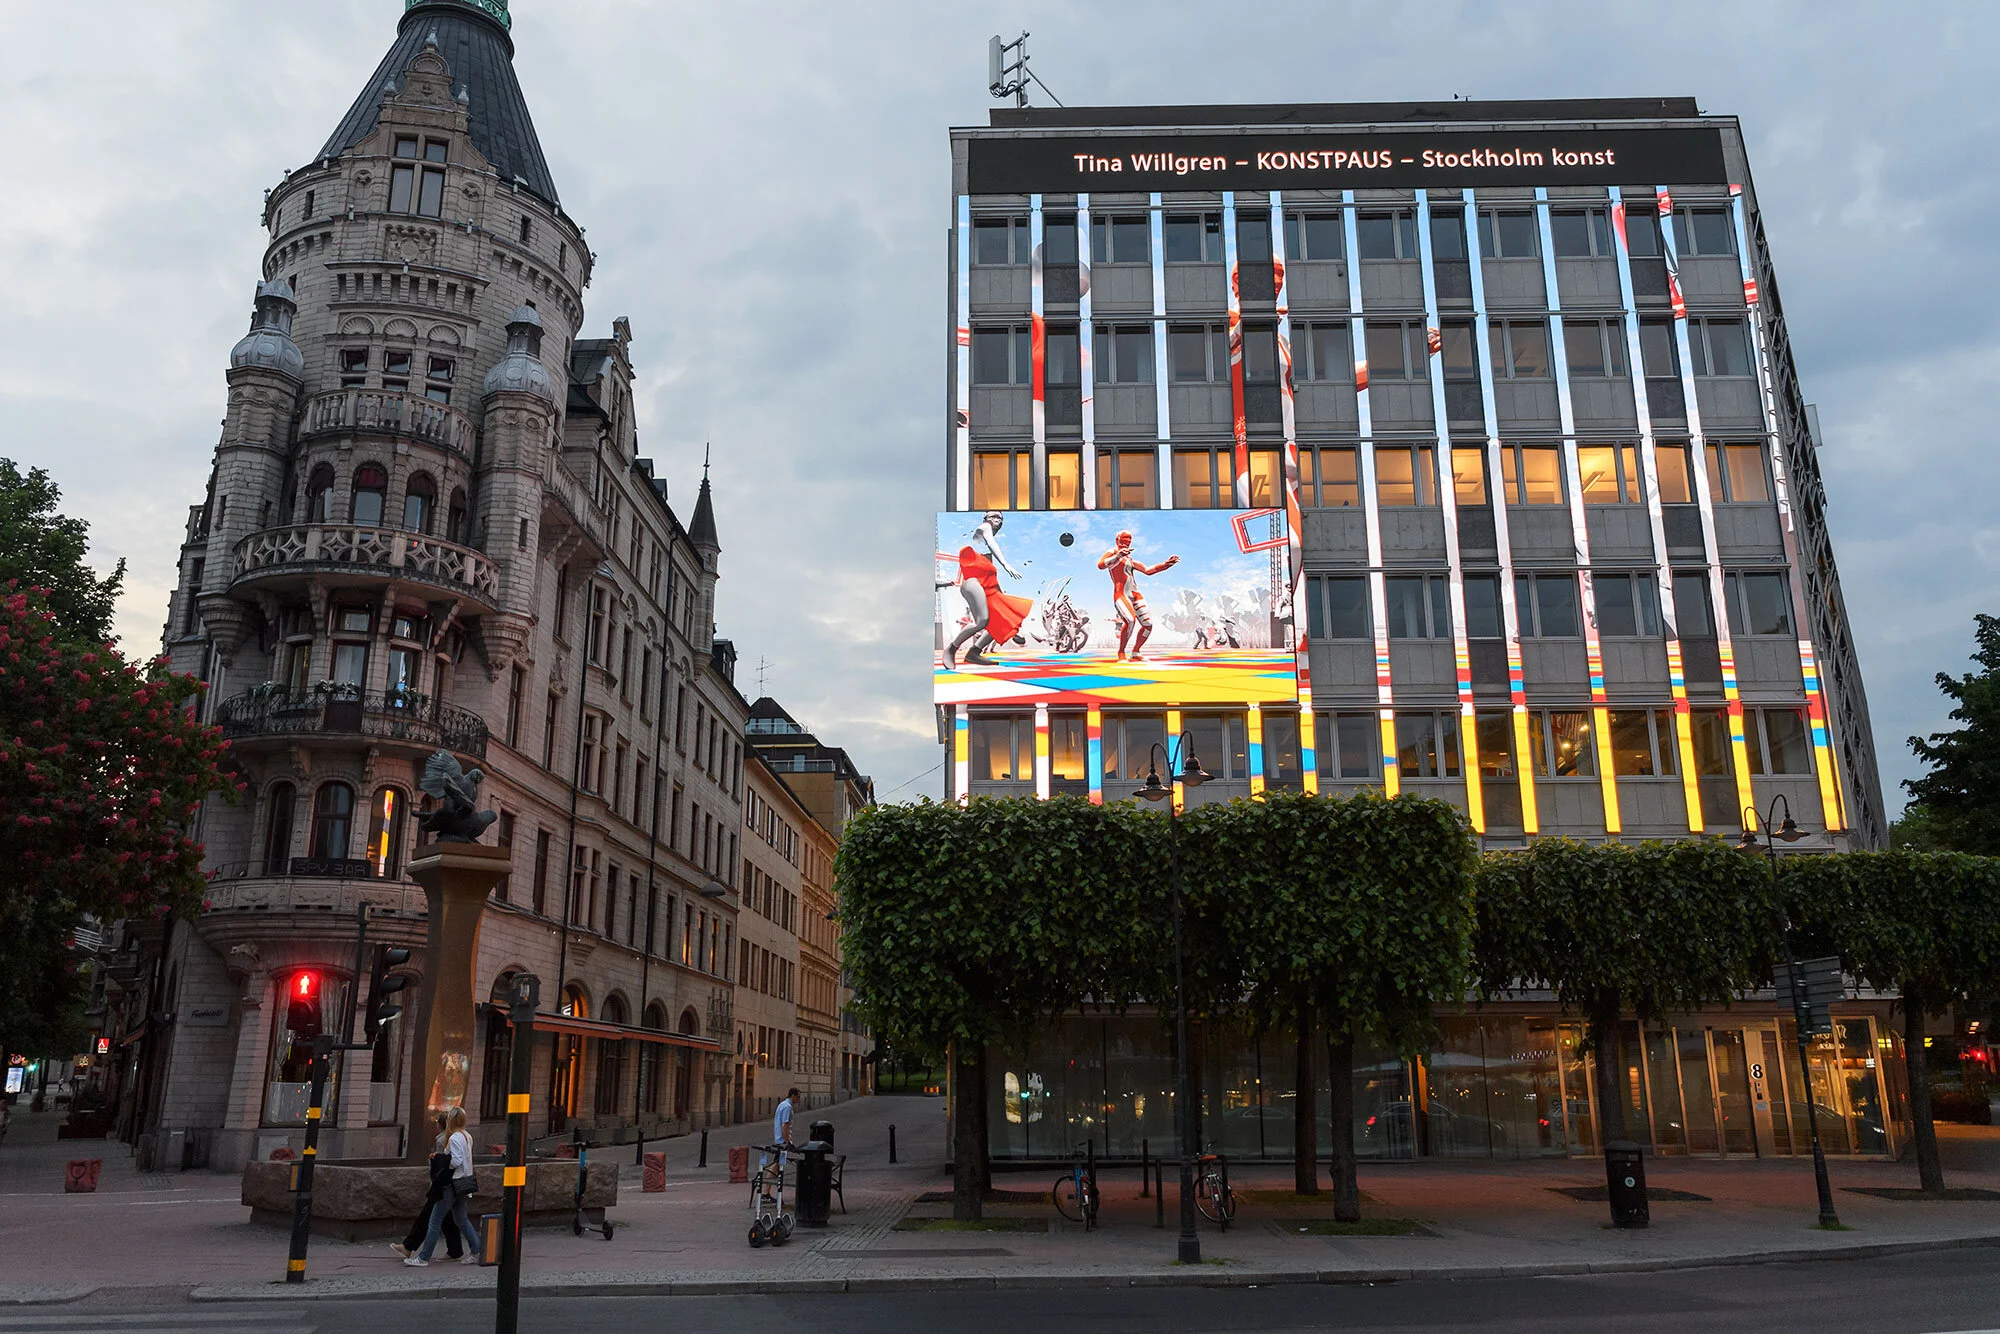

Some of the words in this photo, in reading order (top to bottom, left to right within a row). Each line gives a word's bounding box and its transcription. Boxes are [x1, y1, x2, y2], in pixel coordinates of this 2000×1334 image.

[1073, 154, 1123, 173] Tina
[1130, 152, 1227, 176] Willgren
[1257, 150, 1393, 170] KONSTPAUS
[1422, 148, 1544, 168] Stockholm
[1551, 147, 1616, 166] konst
[295, 862, 329, 874] SPY
[1750, 1063, 1763, 1080] 8
